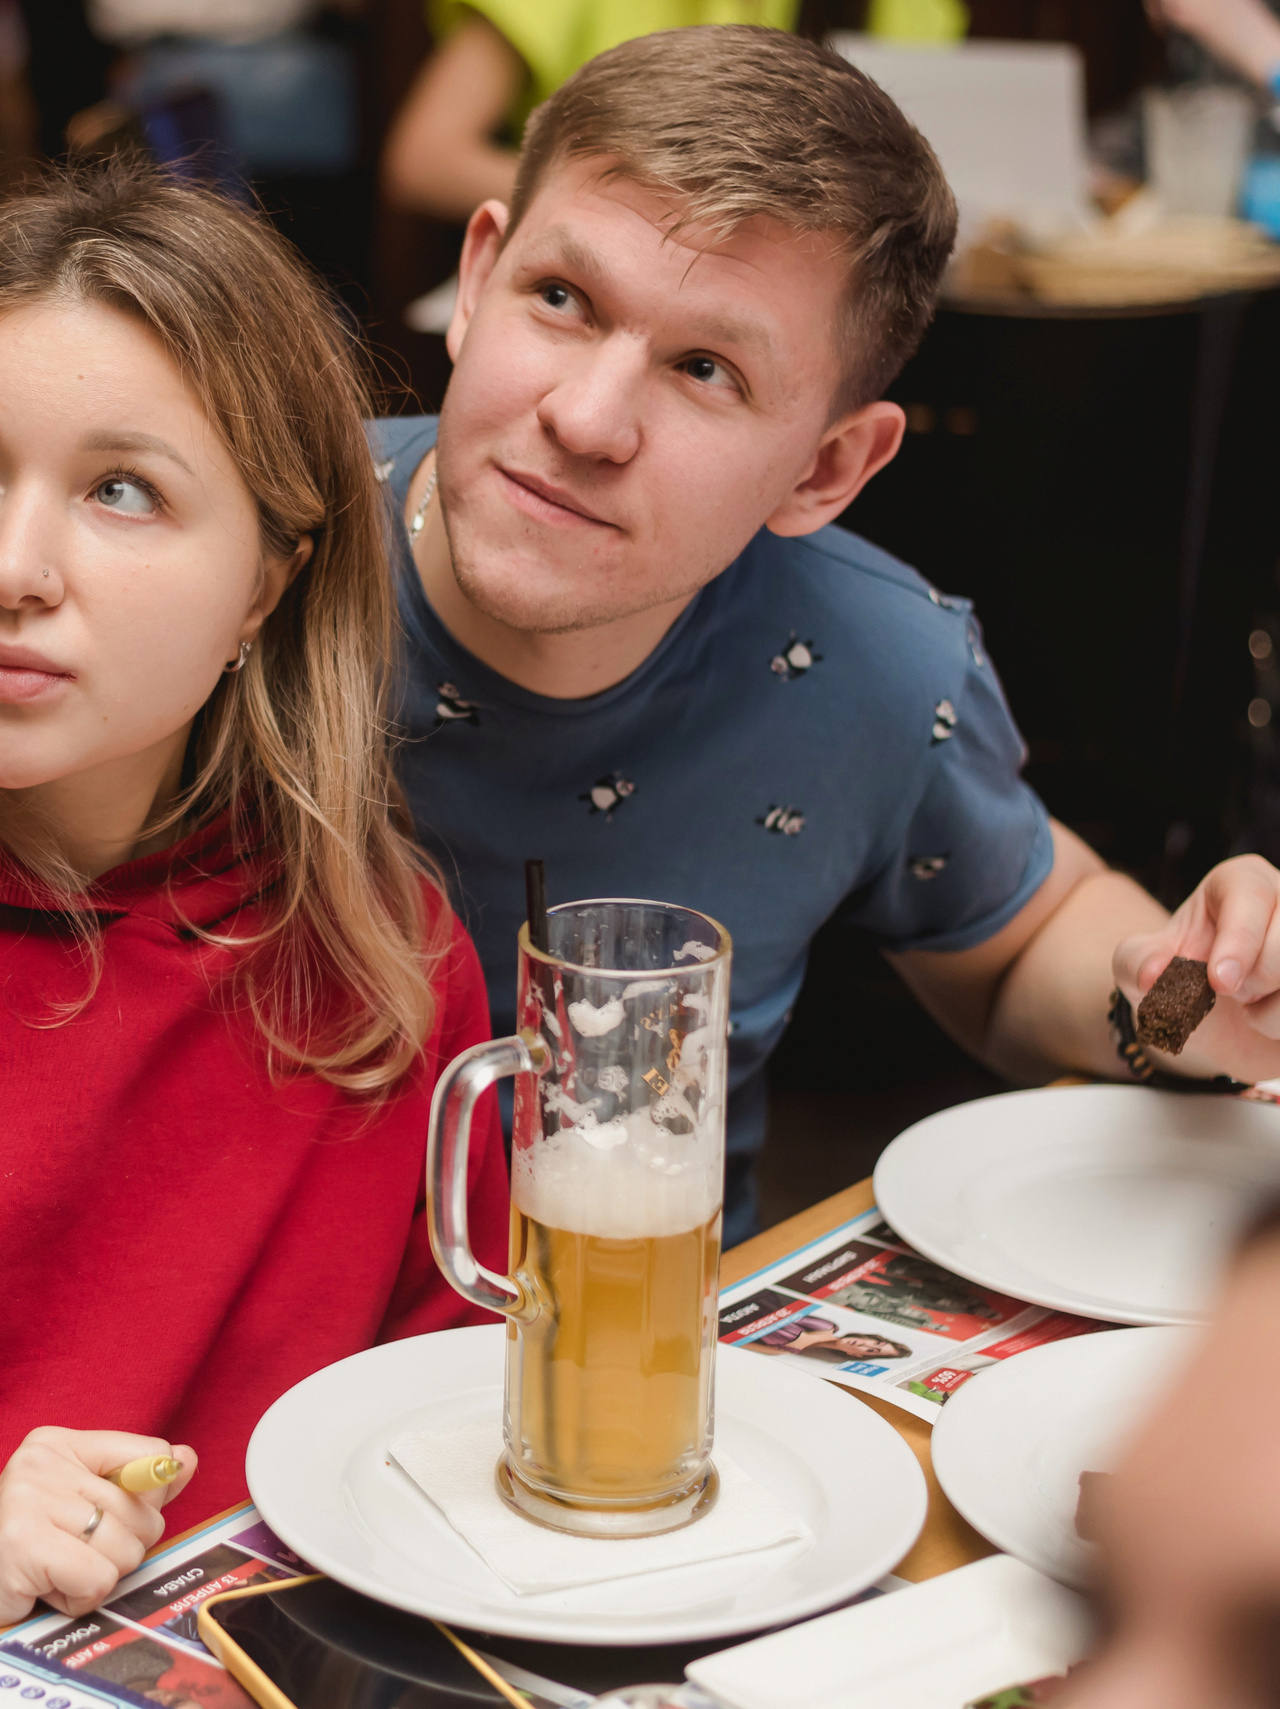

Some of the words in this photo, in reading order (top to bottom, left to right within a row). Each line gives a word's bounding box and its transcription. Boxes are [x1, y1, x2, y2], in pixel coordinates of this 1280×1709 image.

[153, 1567, 205, 1597] СЛАВА
[220, 1573, 239, 1585] 13
[169, 1581, 223, 1613] АПРЕЛЯ
[65, 1647, 93, 1669] АПР
